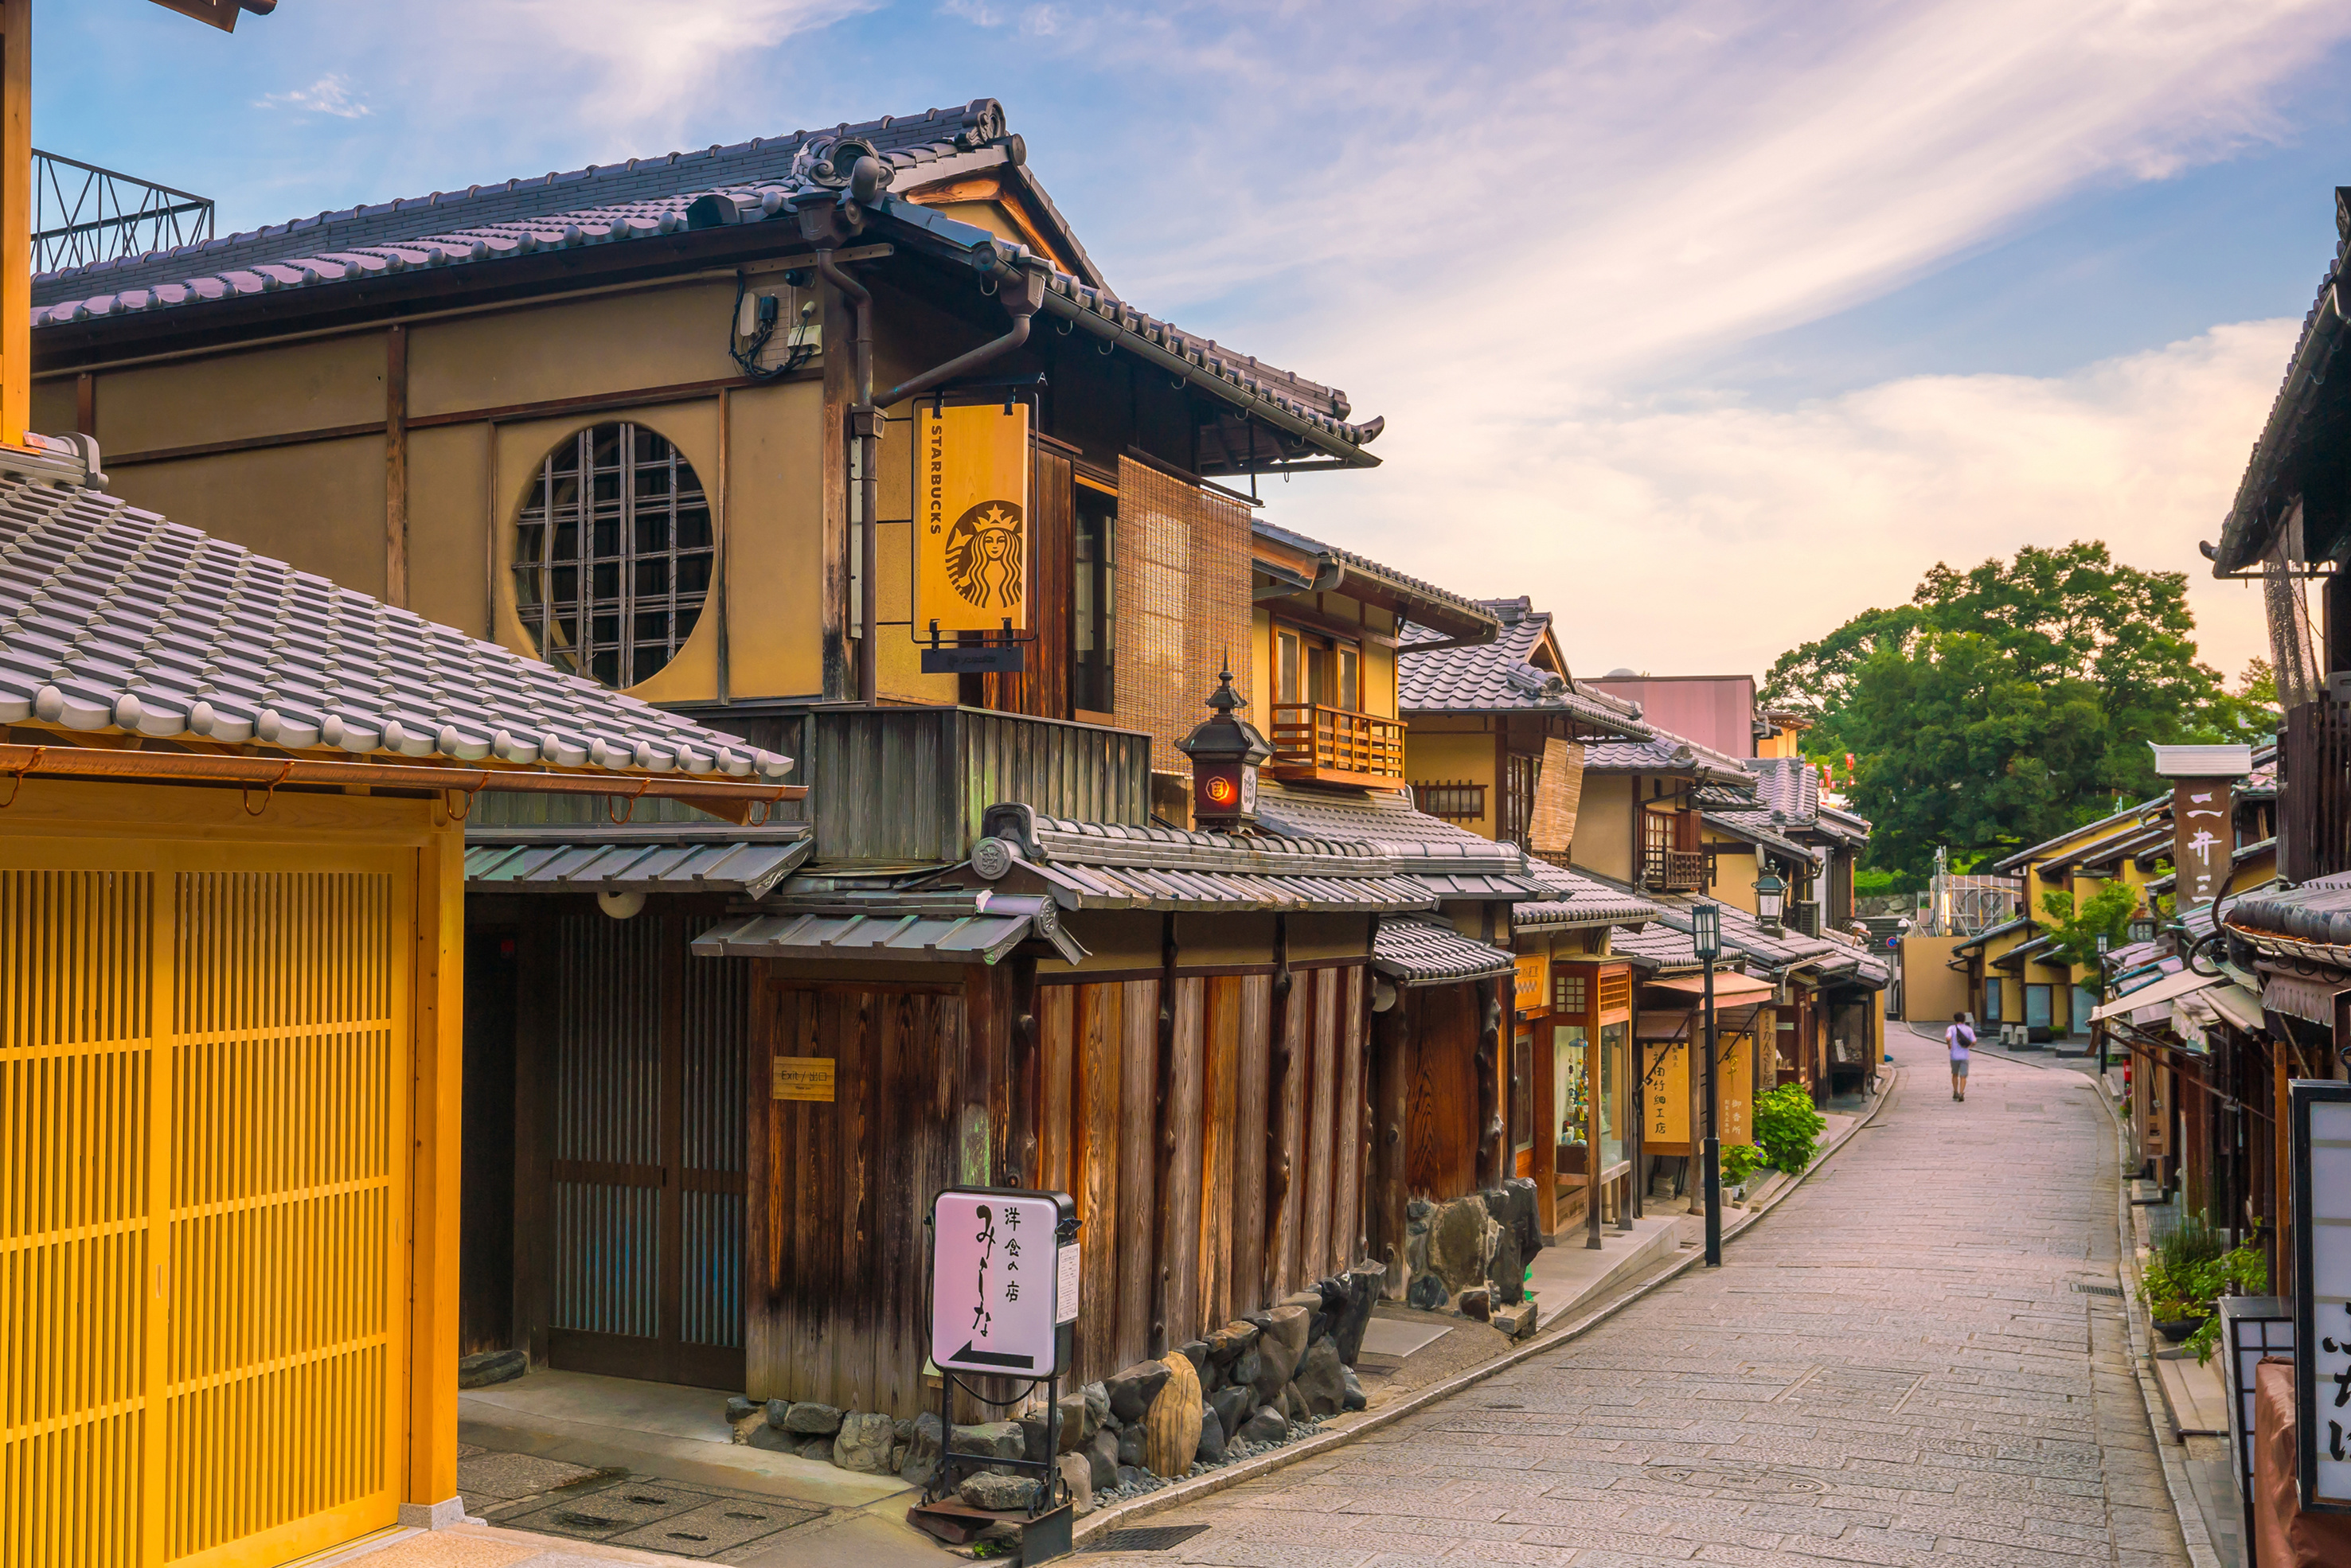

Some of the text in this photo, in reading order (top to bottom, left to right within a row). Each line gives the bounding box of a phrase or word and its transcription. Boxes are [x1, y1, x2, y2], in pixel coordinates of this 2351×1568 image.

[930, 424, 943, 536] STARBUCKS
[2186, 791, 2224, 903] 二井三
[781, 1070, 799, 1081] Exit
[809, 1071, 827, 1082] 出口
[1652, 1051, 1666, 1134] 神田竹細工店
[1004, 1207, 1021, 1303] 洋食の店
